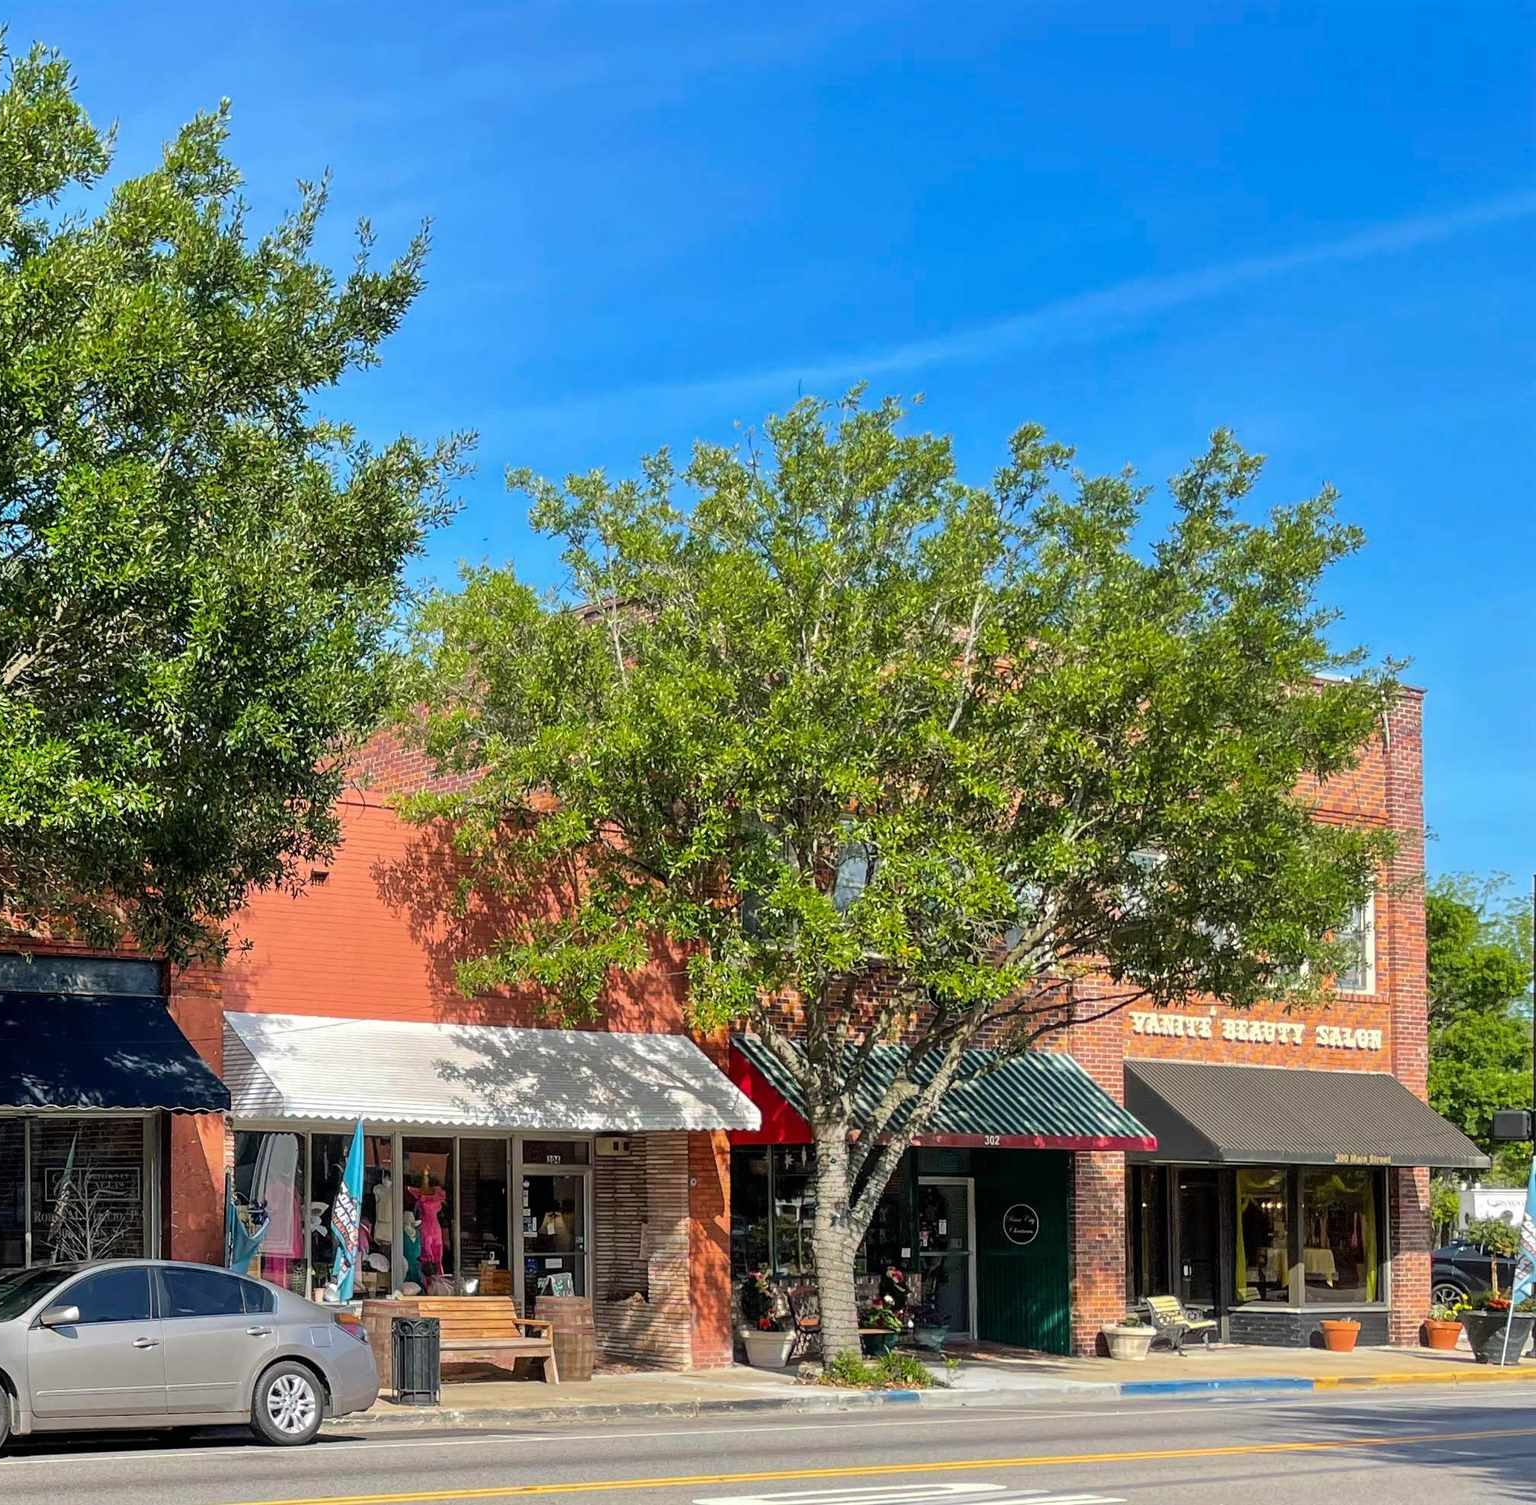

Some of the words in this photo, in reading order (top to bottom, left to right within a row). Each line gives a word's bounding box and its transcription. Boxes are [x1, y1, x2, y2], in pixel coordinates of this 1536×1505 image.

[1222, 1018, 1305, 1046] BEAUTY
[1316, 1024, 1382, 1051] SALON
[984, 1134, 1000, 1146] 302
[1350, 1153, 1368, 1164] Main
[1369, 1153, 1392, 1165] Street
